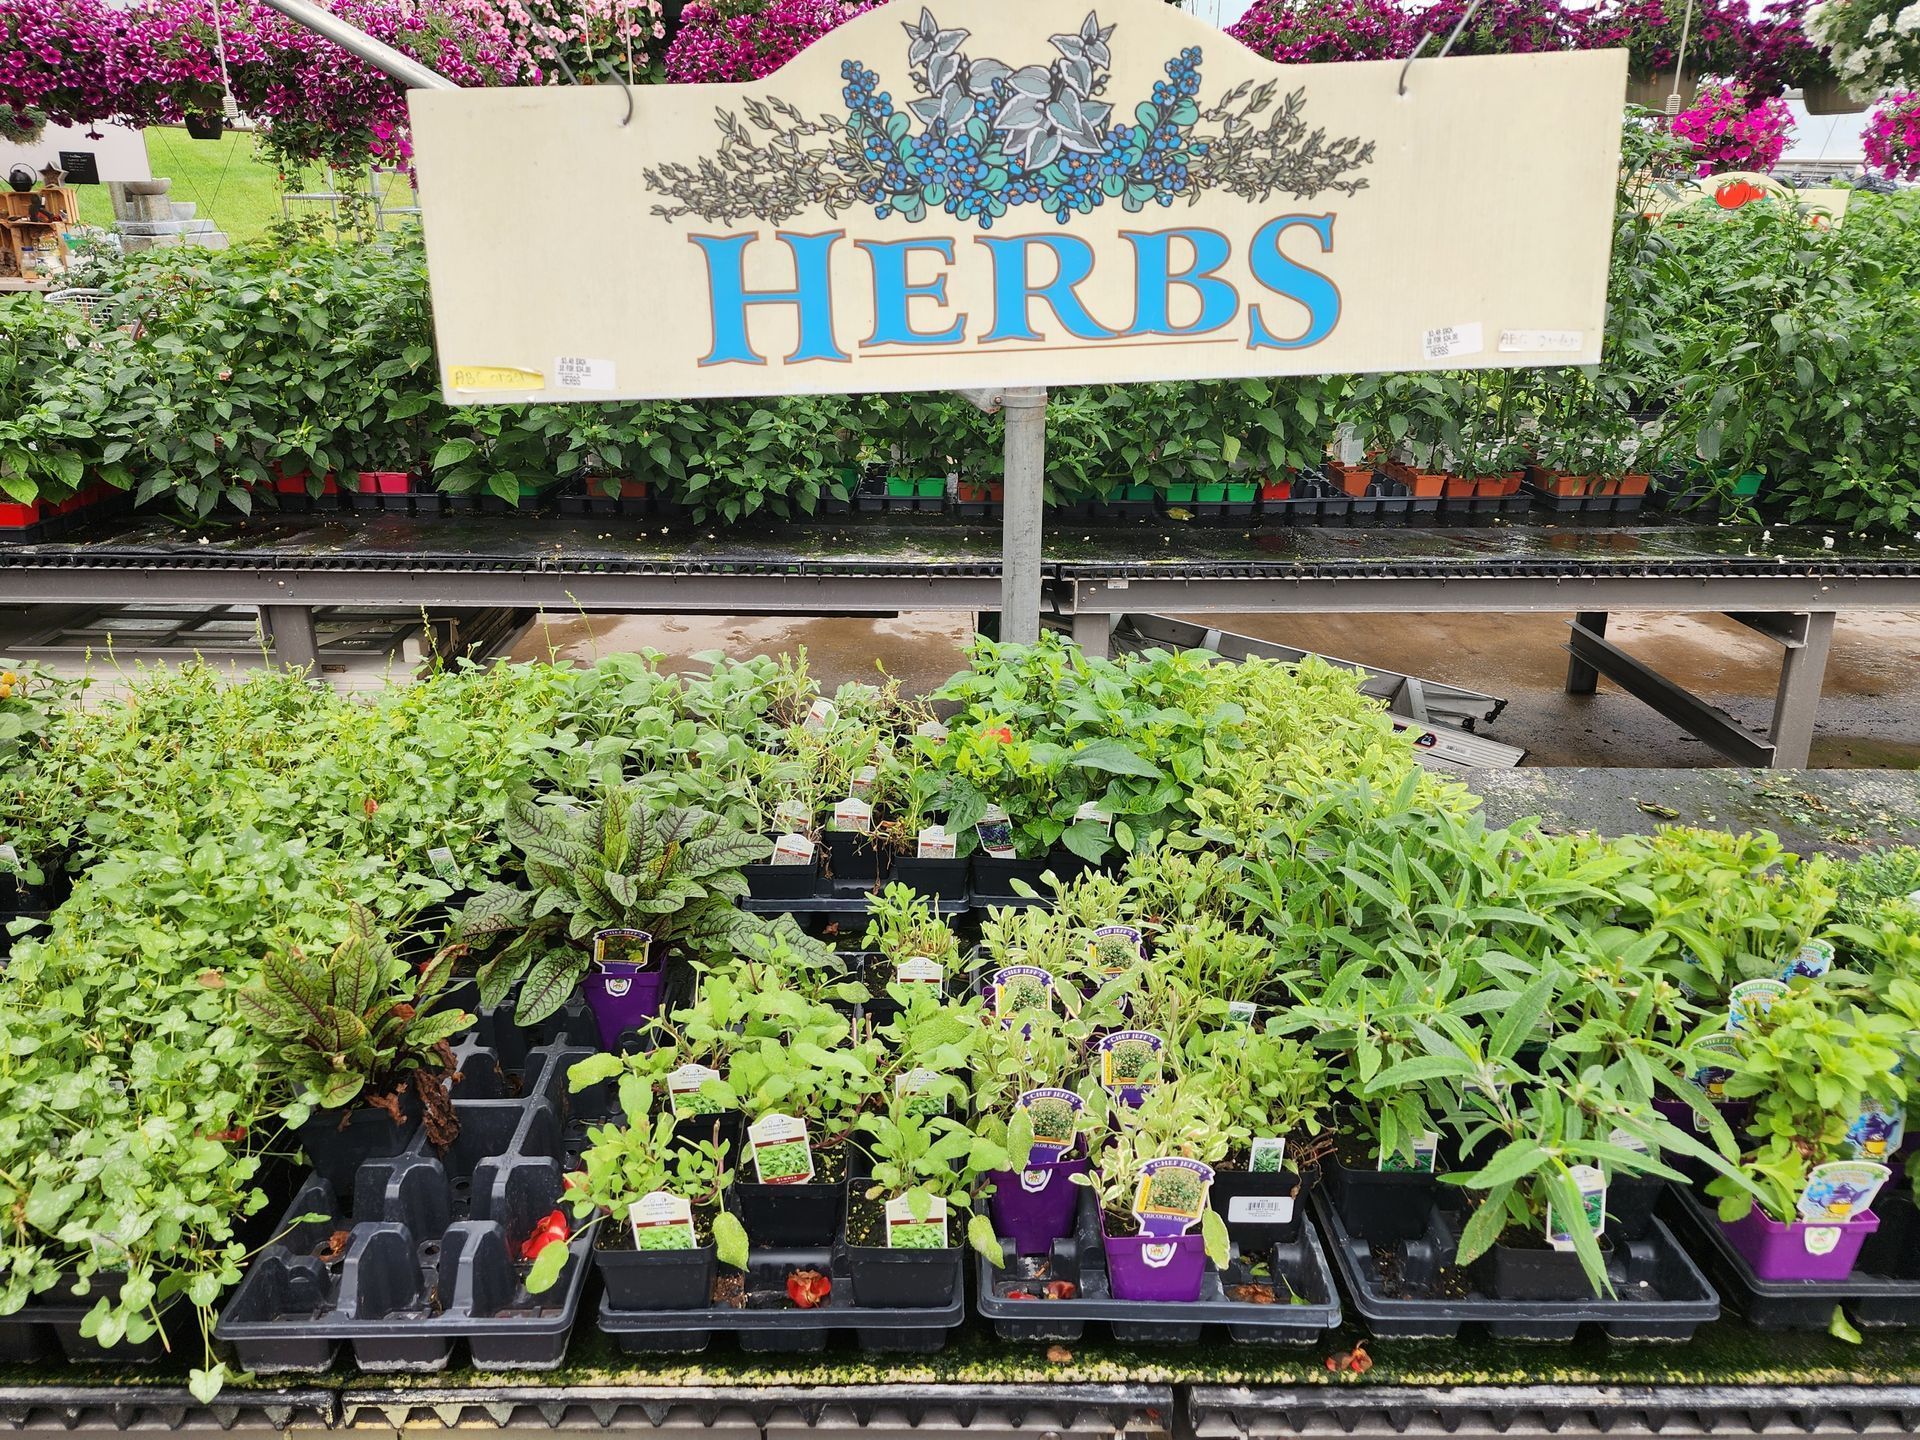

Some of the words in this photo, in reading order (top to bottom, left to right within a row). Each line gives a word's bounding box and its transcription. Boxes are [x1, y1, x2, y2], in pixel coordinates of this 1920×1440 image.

[688, 212, 1342, 369] HERBS
[1430, 345, 1449, 357] HERBS
[562, 375, 581, 386] HERBS
[1003, 968, 1021, 977] CHEF
[1110, 1033, 1130, 1043] CHEF
[1132, 1033, 1155, 1043] JEFF'S
[1029, 1090, 1053, 1100] CHEF
[1053, 1091, 1076, 1103] JEFF'S
[1154, 1159, 1179, 1169] CHEF
[1180, 1160, 1205, 1174] JEFF'S
[1143, 1212, 1173, 1221] TRICOLOR
